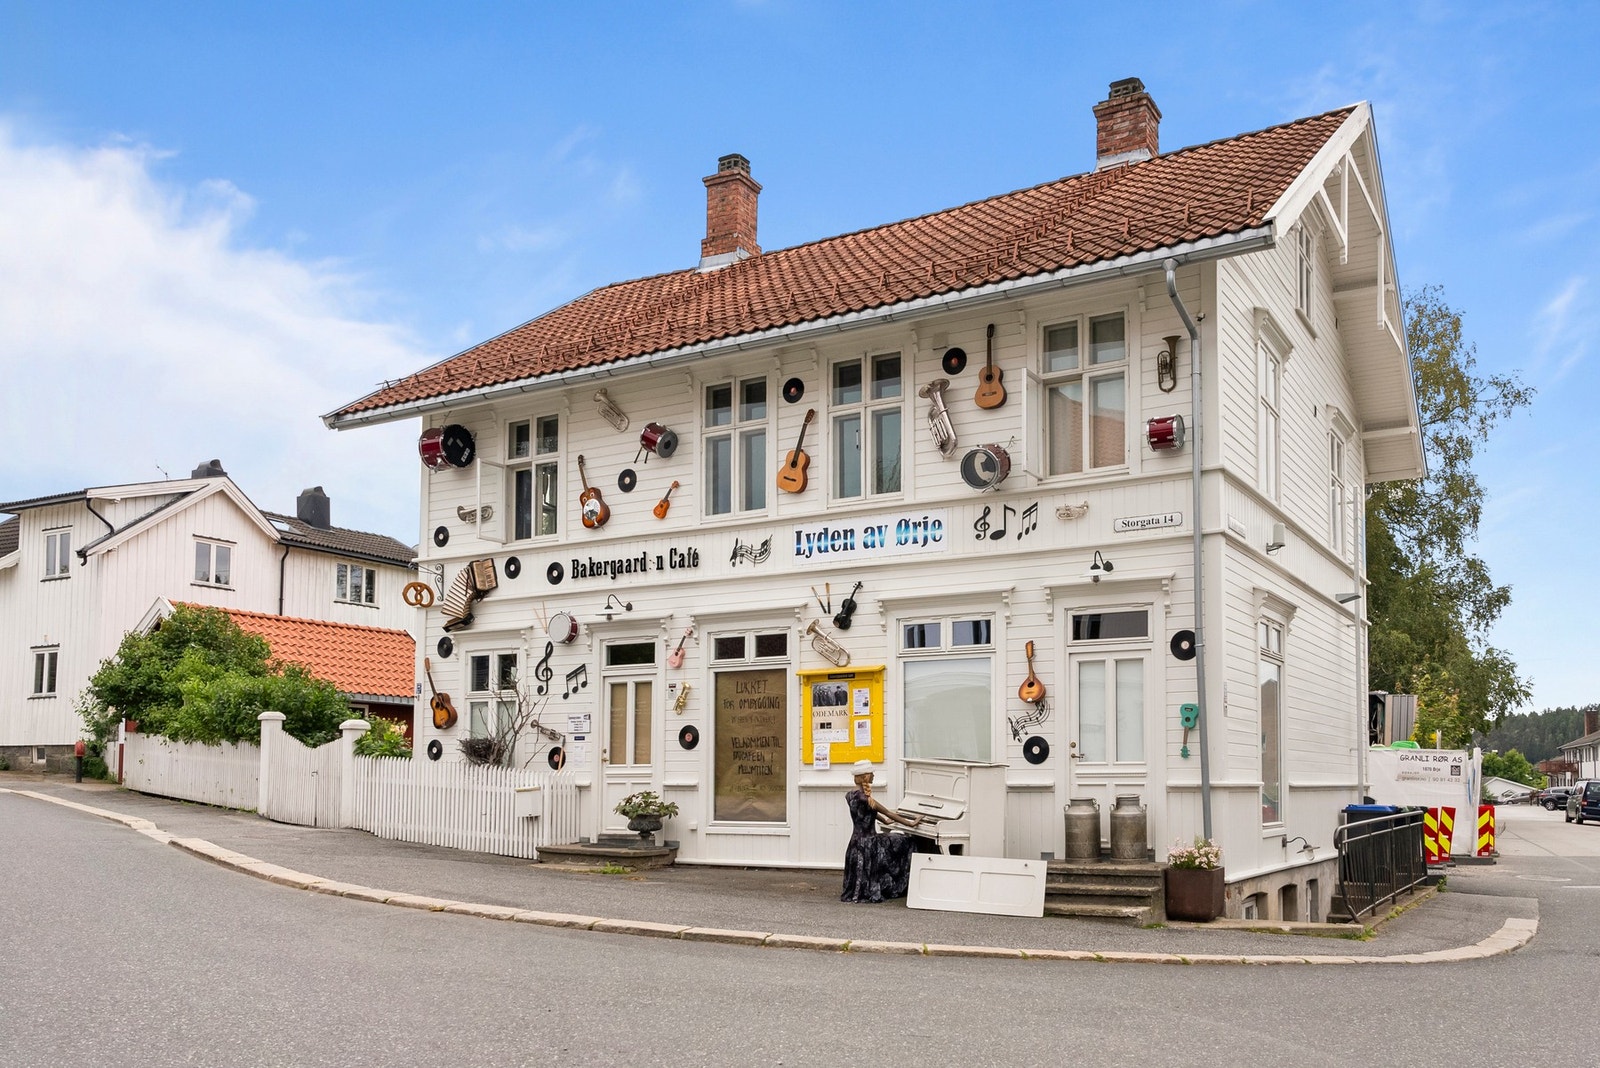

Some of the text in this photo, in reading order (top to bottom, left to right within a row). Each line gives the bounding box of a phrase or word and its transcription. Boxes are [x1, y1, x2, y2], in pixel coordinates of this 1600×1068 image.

[1121, 514, 1174, 528] Storgata 14
[795, 516, 943, 559] Lyden av Ørje
[669, 546, 700, 569] Café
[735, 679, 769, 695] LUKKET
[739, 696, 780, 710] OMBYGGING
[1400, 754, 1463, 764] GRANLI RØR AS
